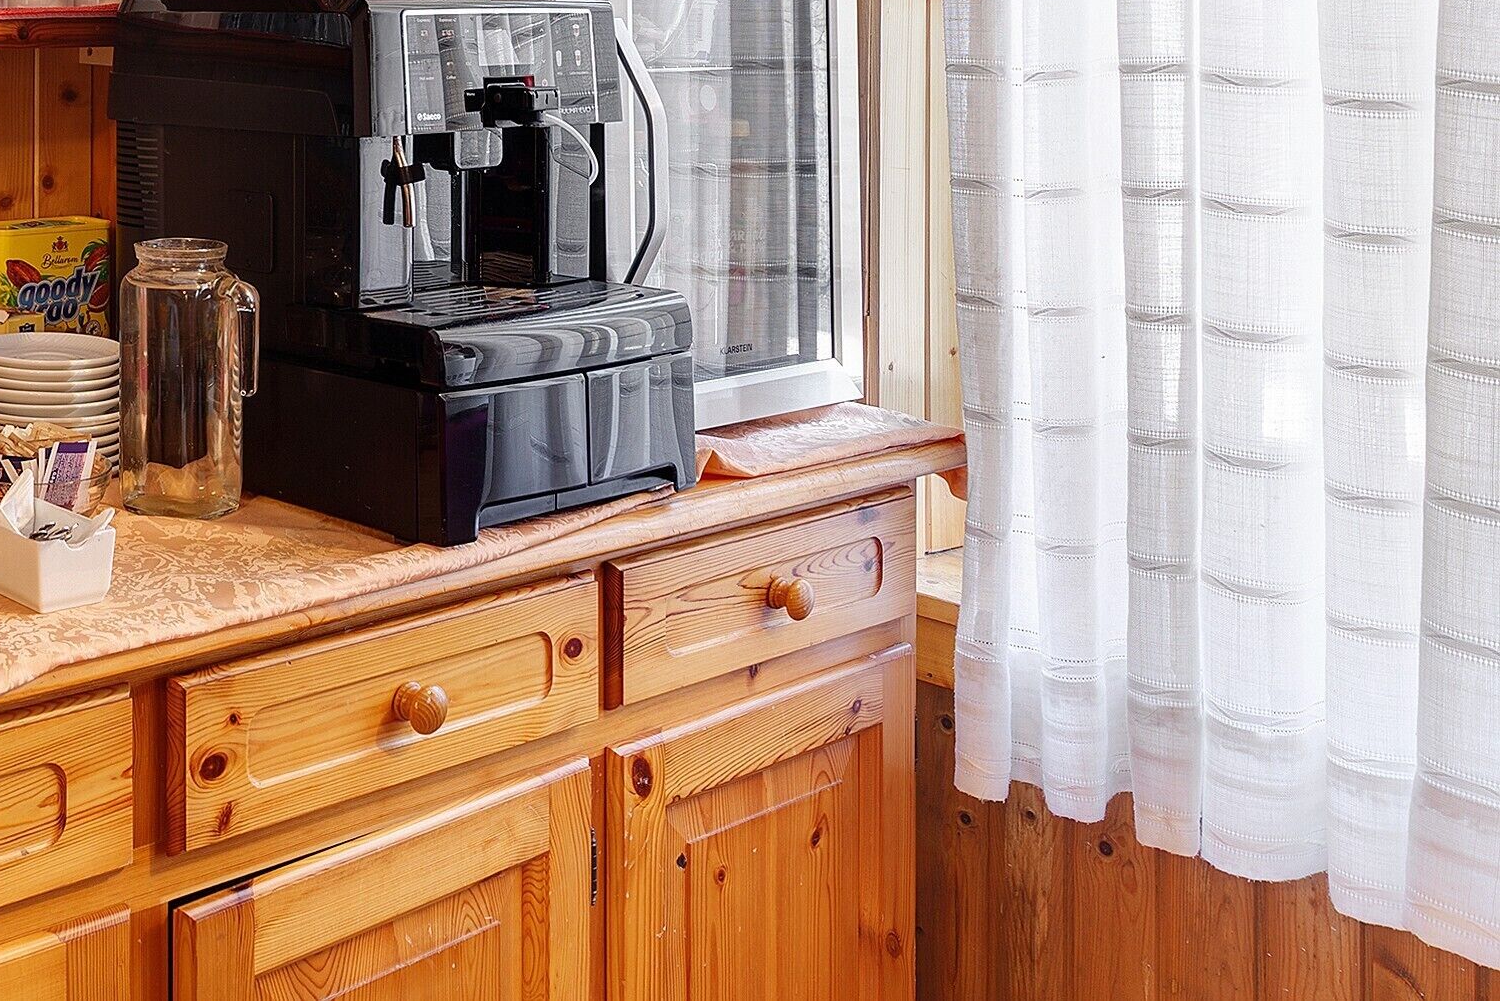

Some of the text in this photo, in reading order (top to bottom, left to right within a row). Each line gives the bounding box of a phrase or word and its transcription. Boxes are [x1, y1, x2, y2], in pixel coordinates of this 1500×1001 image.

[422, 112, 441, 121] Saeco
[17, 266, 100, 311] goody
[720, 344, 753, 355] KLARSTEIN
